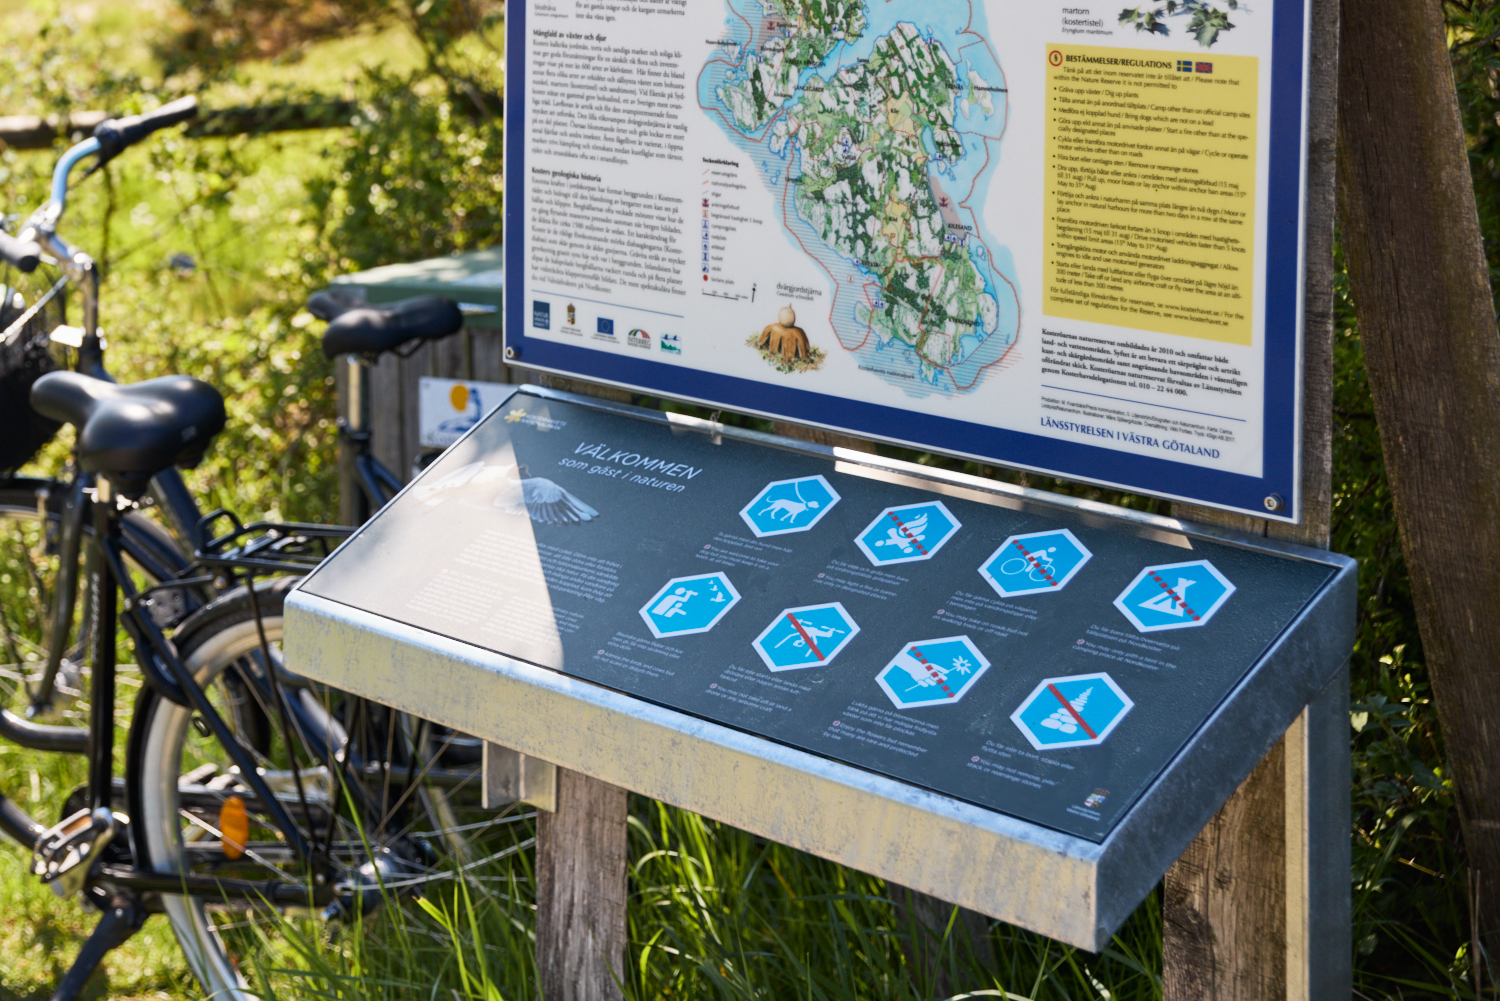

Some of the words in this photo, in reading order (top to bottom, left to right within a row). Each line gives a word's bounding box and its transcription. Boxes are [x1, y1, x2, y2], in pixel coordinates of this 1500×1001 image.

[1062, 18, 1104, 28] (kostertistel)
[1066, 55, 1172, 69] BESTÄMMELSER/REGULATIONS
[1077, 67, 1084, 76] på
[1164, 73, 1182, 81] tillåtet
[1195, 76, 1213, 84] Please
[1080, 76, 1100, 84] Nature
[1100, 77, 1122, 85] Reserve
[1104, 89, 1115, 98] Dig
[1123, 91, 1139, 99] plants
[532, 167, 551, 176] Kosters
[552, 170, 580, 180] geologiska
[580, 173, 601, 182] historia
[776, 282, 822, 297] dvärgjordstjärna
[1042, 327, 1078, 340] Kosteröarnas
[1078, 334, 1116, 346] naturreservat
[1116, 340, 1150, 351] ombildades
[1151, 344, 1157, 352] år
[1158, 345, 1174, 355] 2010
[1187, 351, 1213, 361] omfattar
[1214, 354, 1229, 363] både
[1040, 416, 1114, 439] LÄNSSTYRELSEN
[1122, 432, 1159, 447] VÄSTRA
[1162, 439, 1220, 459] GÖTALAND
[574, 442, 703, 480] VÄLKOMMEN
[558, 457, 588, 469] som
[588, 465, 623, 477] gäst
[629, 474, 686, 493] naturen
